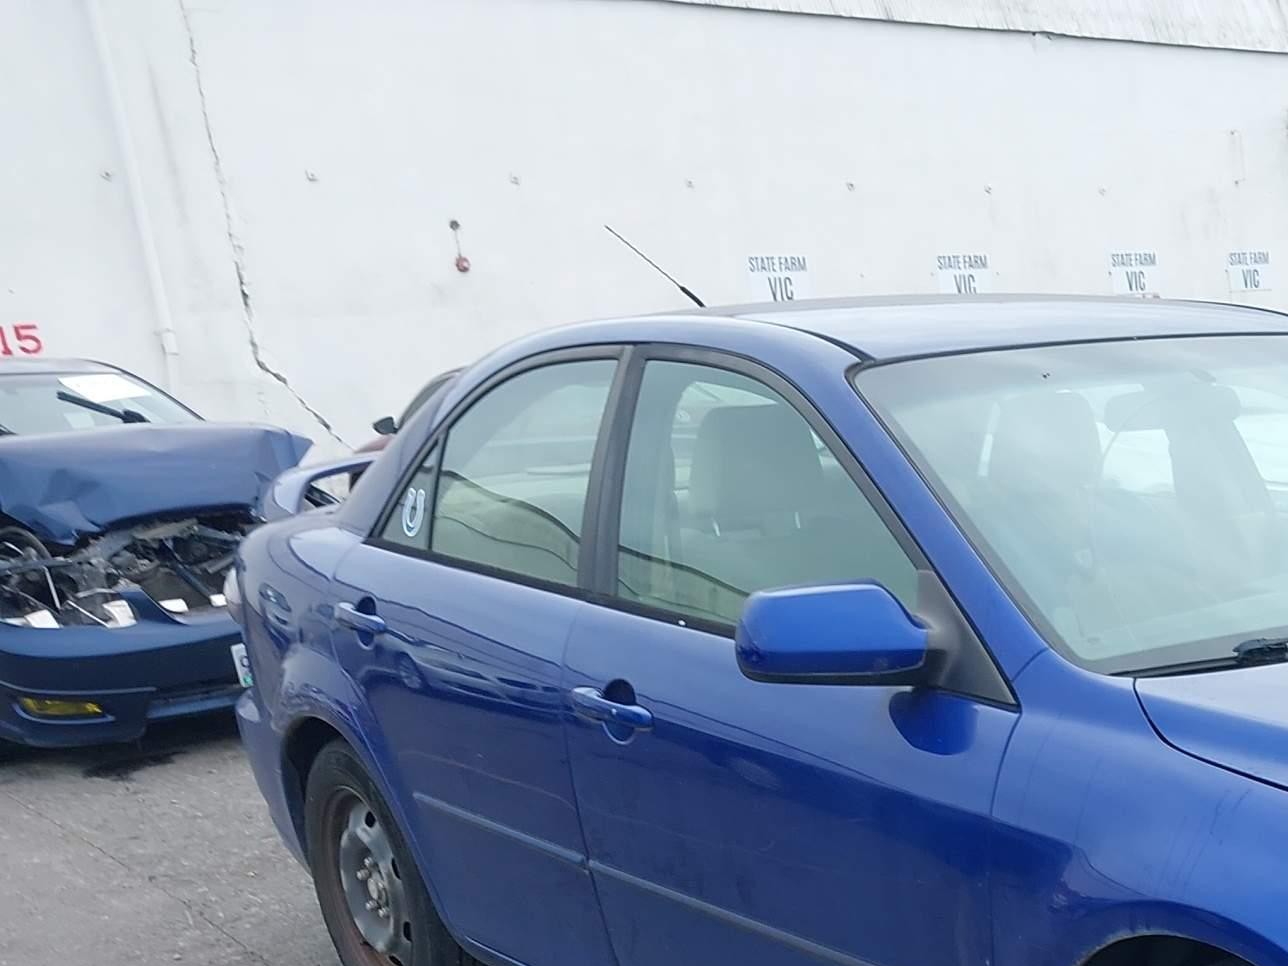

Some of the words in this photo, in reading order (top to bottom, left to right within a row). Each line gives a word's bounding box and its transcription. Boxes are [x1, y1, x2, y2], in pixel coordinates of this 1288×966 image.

[748, 256, 777, 273] STATE
[778, 256, 807, 272] FARM
[937, 255, 961, 270] STATE
[962, 254, 988, 270] FARM
[1111, 253, 1133, 267] STATE
[1134, 253, 1156, 267] FARM
[1229, 252, 1248, 266] STATE
[1249, 251, 1269, 265] FARM
[953, 273, 977, 295] VIC
[1125, 270, 1146, 292] VIC
[1242, 269, 1260, 289] VIC
[767, 276, 794, 302] VIC
